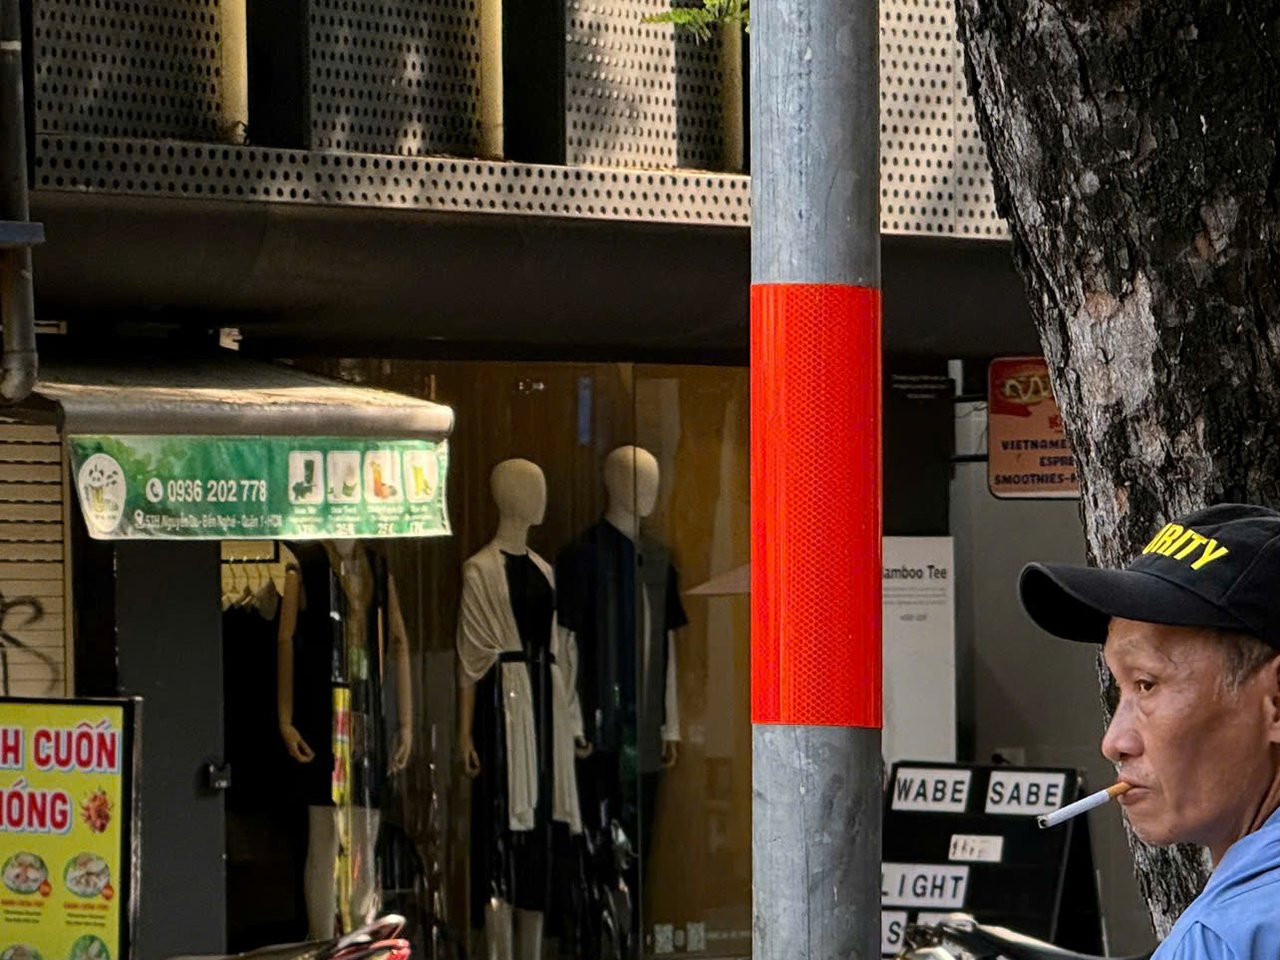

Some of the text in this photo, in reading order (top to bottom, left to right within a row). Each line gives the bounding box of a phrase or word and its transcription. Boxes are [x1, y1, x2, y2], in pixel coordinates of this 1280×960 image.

[167, 479, 267, 503] 0936 202 778
[926, 564, 947, 579] Tee
[34, 719, 117, 769] CUỐN
[897, 777, 1060, 807] WABE SABE
